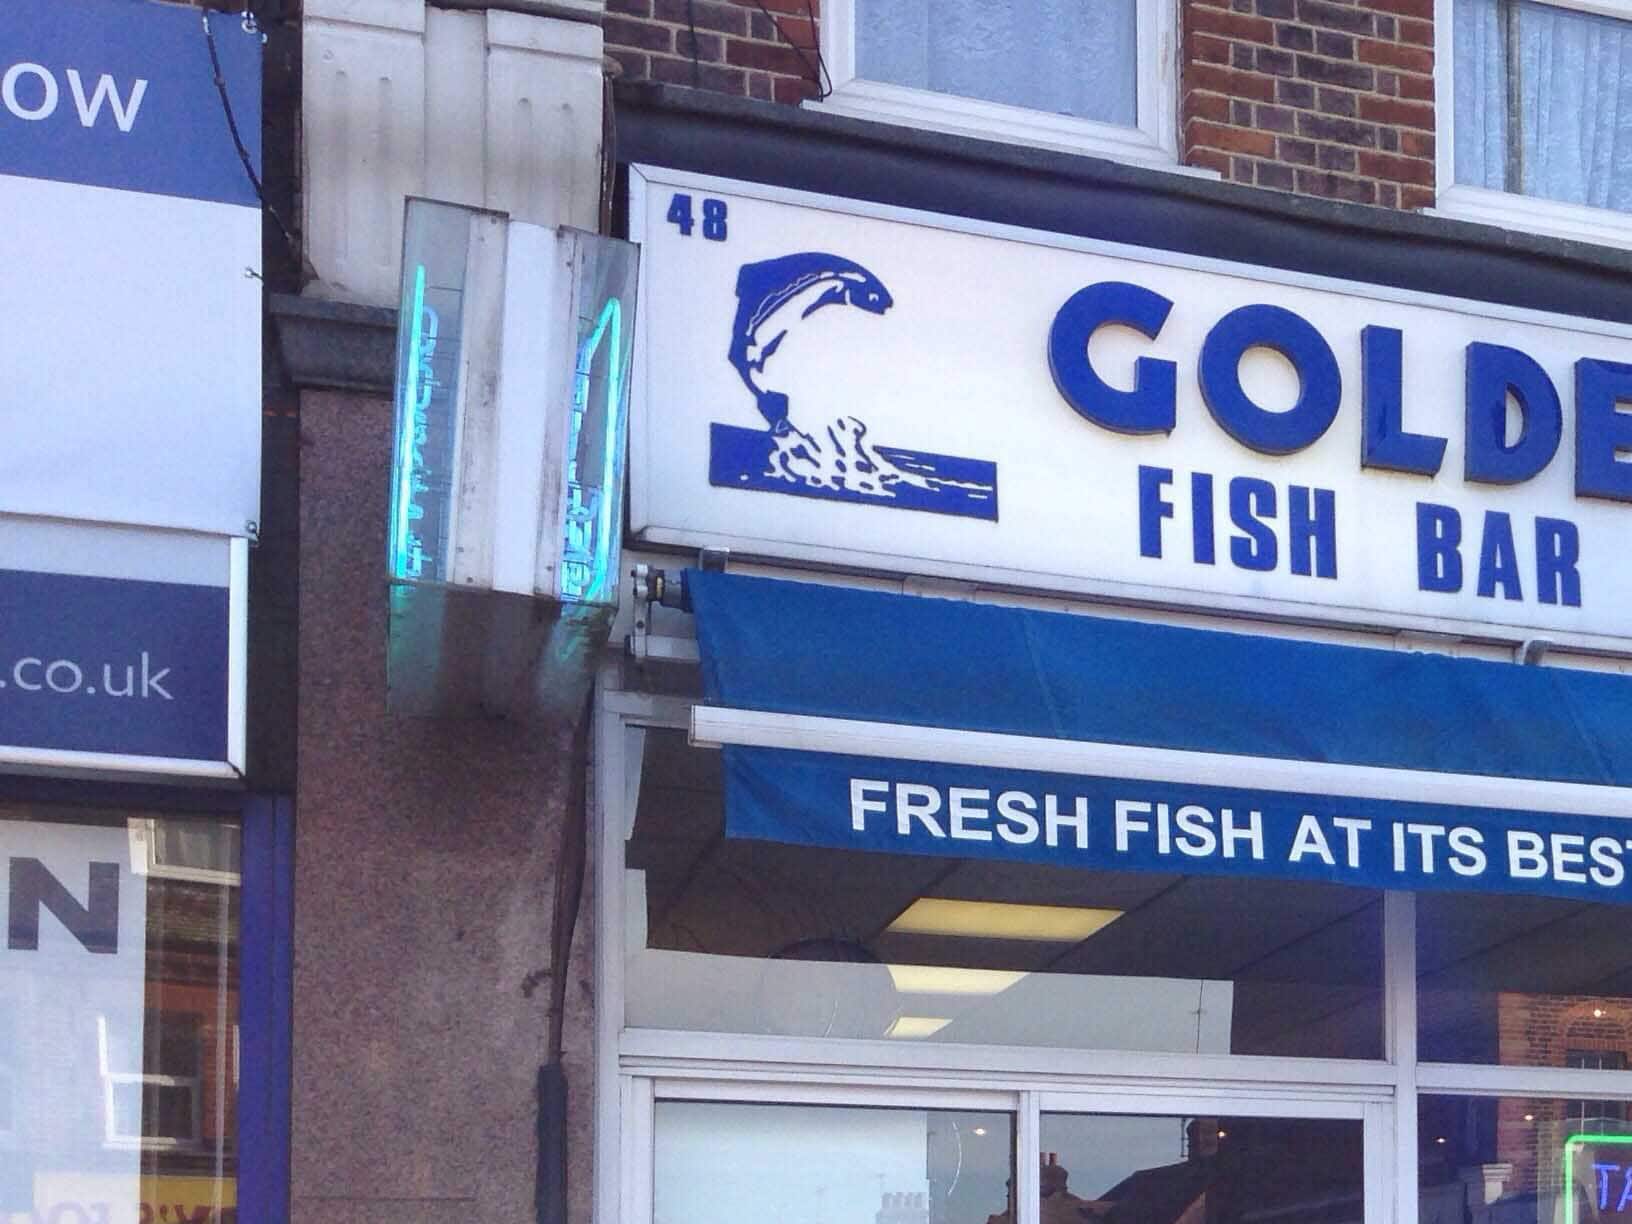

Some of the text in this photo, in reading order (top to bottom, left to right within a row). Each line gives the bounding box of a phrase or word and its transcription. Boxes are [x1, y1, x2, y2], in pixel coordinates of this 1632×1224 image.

[1, 61, 148, 132] OW
[666, 193, 728, 242] 48
[1138, 464, 1582, 608] FISH BAR
[849, 778, 1089, 850] FRESH
[1115, 800, 1265, 861] FISH
[1289, 813, 1371, 869] AT
[1392, 821, 1488, 877] ITS
[8, 856, 120, 955] N
